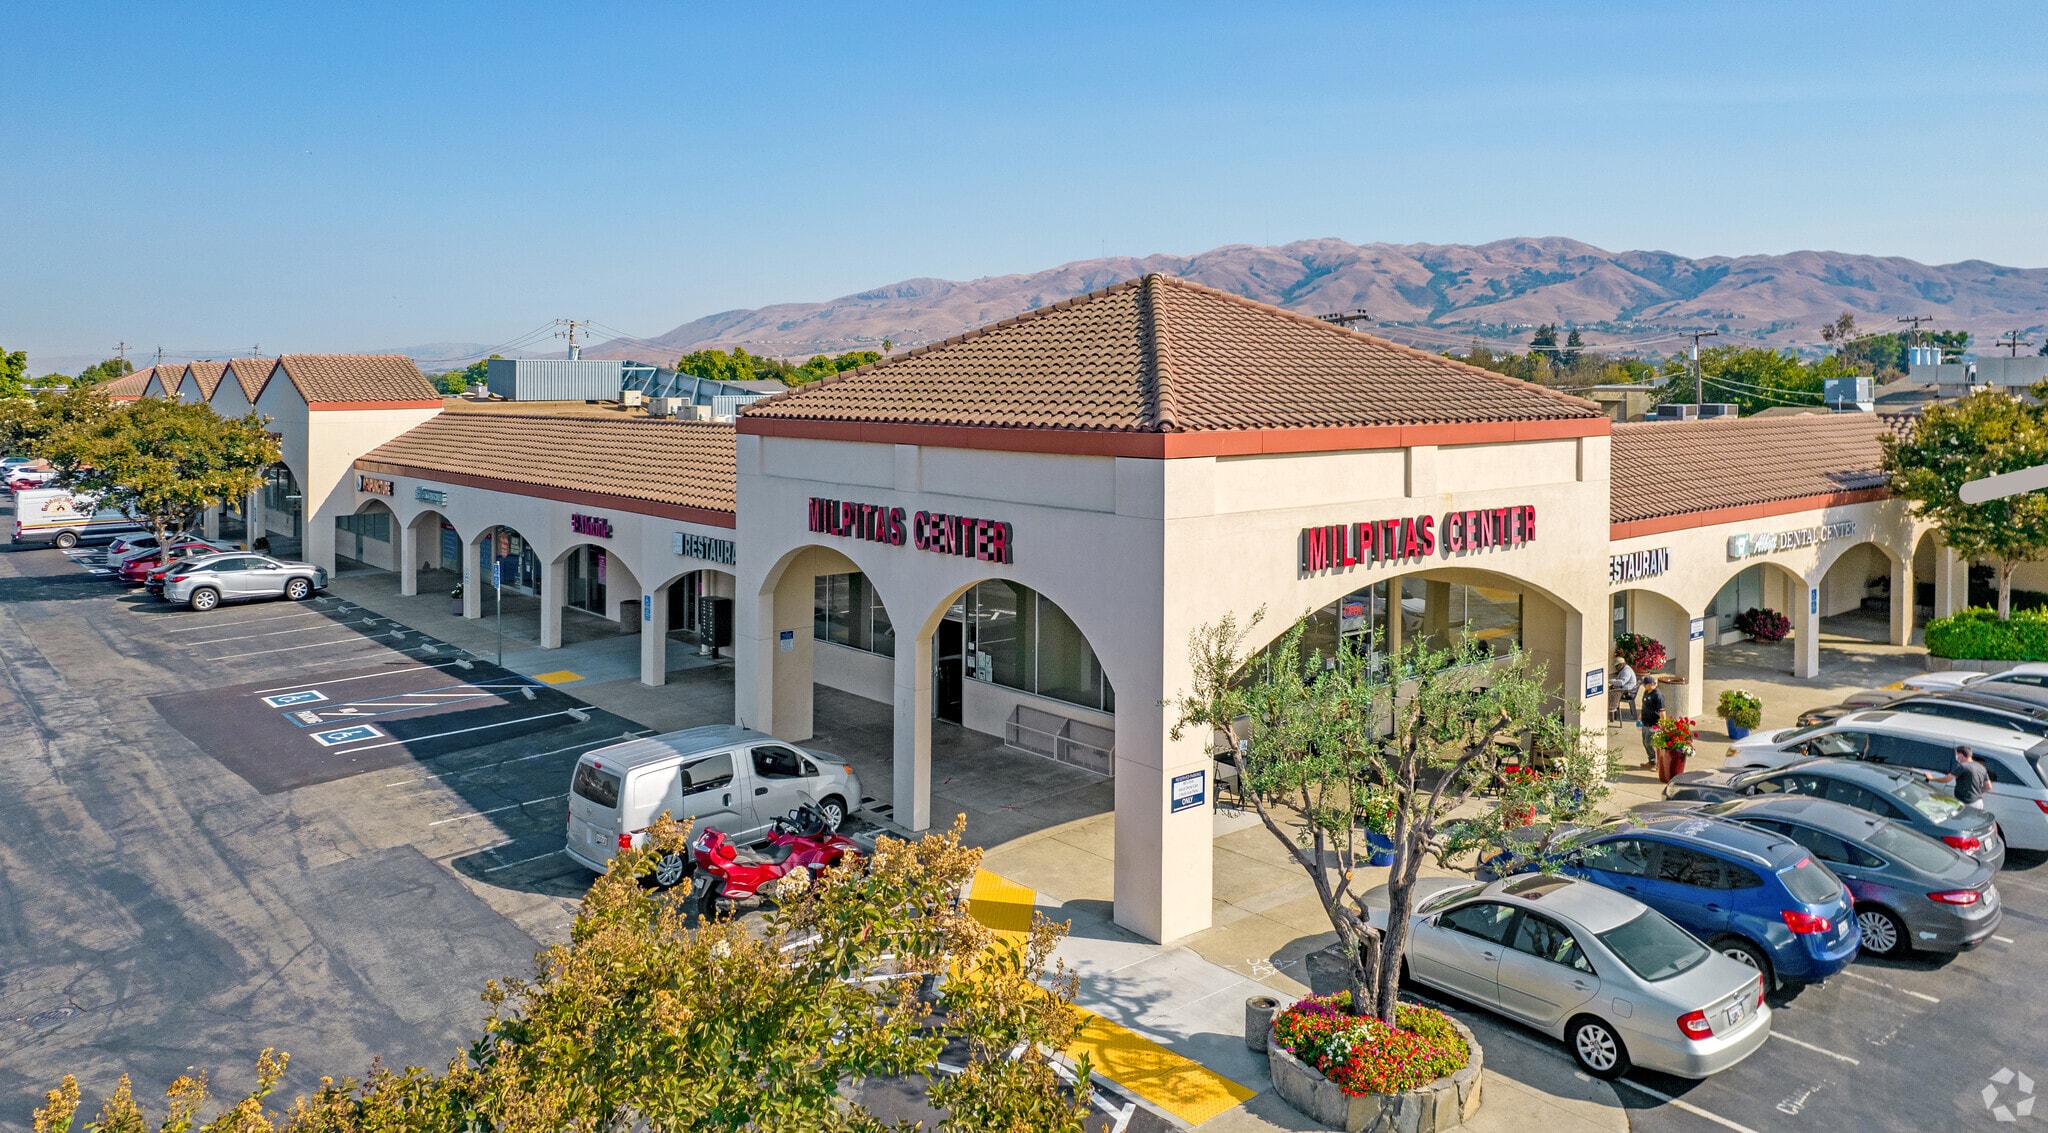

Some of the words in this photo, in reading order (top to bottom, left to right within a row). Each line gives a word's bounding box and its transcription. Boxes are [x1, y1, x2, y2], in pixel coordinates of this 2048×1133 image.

[808, 497, 906, 546] MILPITAS
[913, 510, 1013, 565] CENTER
[1304, 515, 1435, 572] MILPITAS
[1445, 504, 1537, 552] CENTER
[1780, 526, 1819, 549] DENTAL
[1820, 521, 1857, 542] CENTER
[1343, 605, 1363, 617] OPEN
